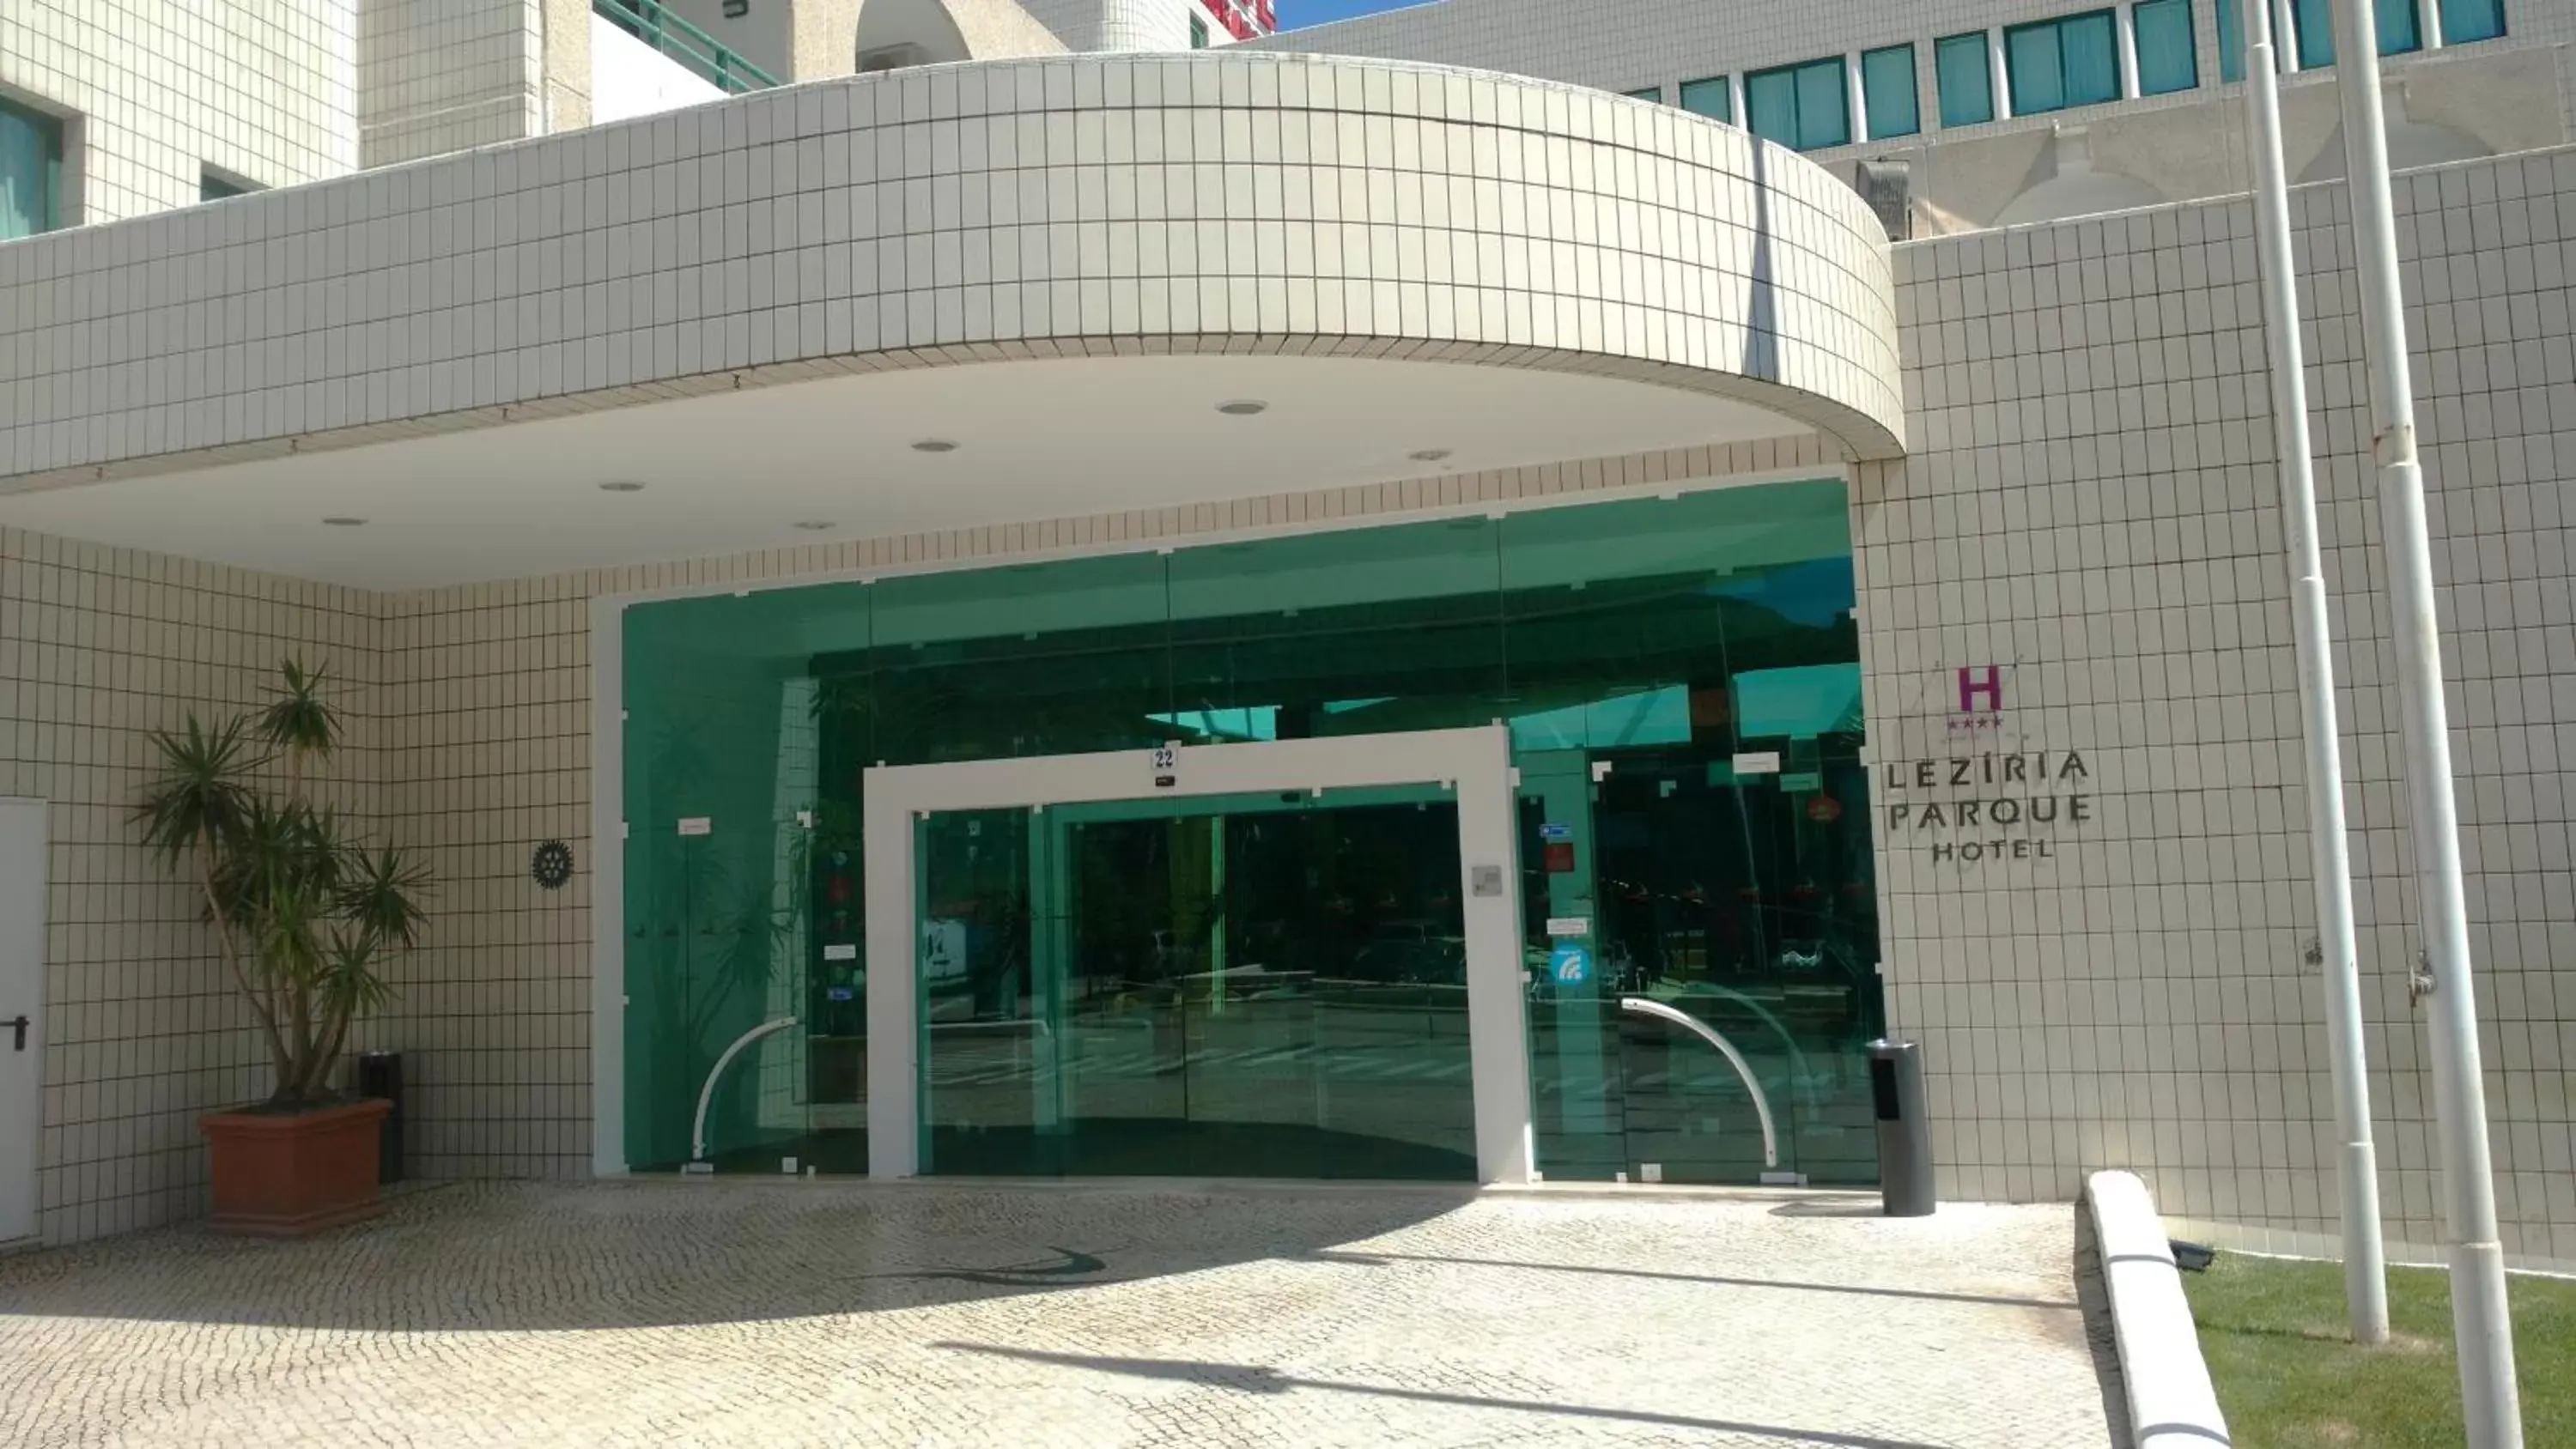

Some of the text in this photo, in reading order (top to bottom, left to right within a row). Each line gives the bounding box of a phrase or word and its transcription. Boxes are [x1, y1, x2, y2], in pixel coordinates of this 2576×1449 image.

[1959, 665, 2002, 711] H
[1155, 749, 1173, 768] 22
[1890, 794, 2091, 830] PARQUE
[1933, 839, 2053, 862] HOTEL
